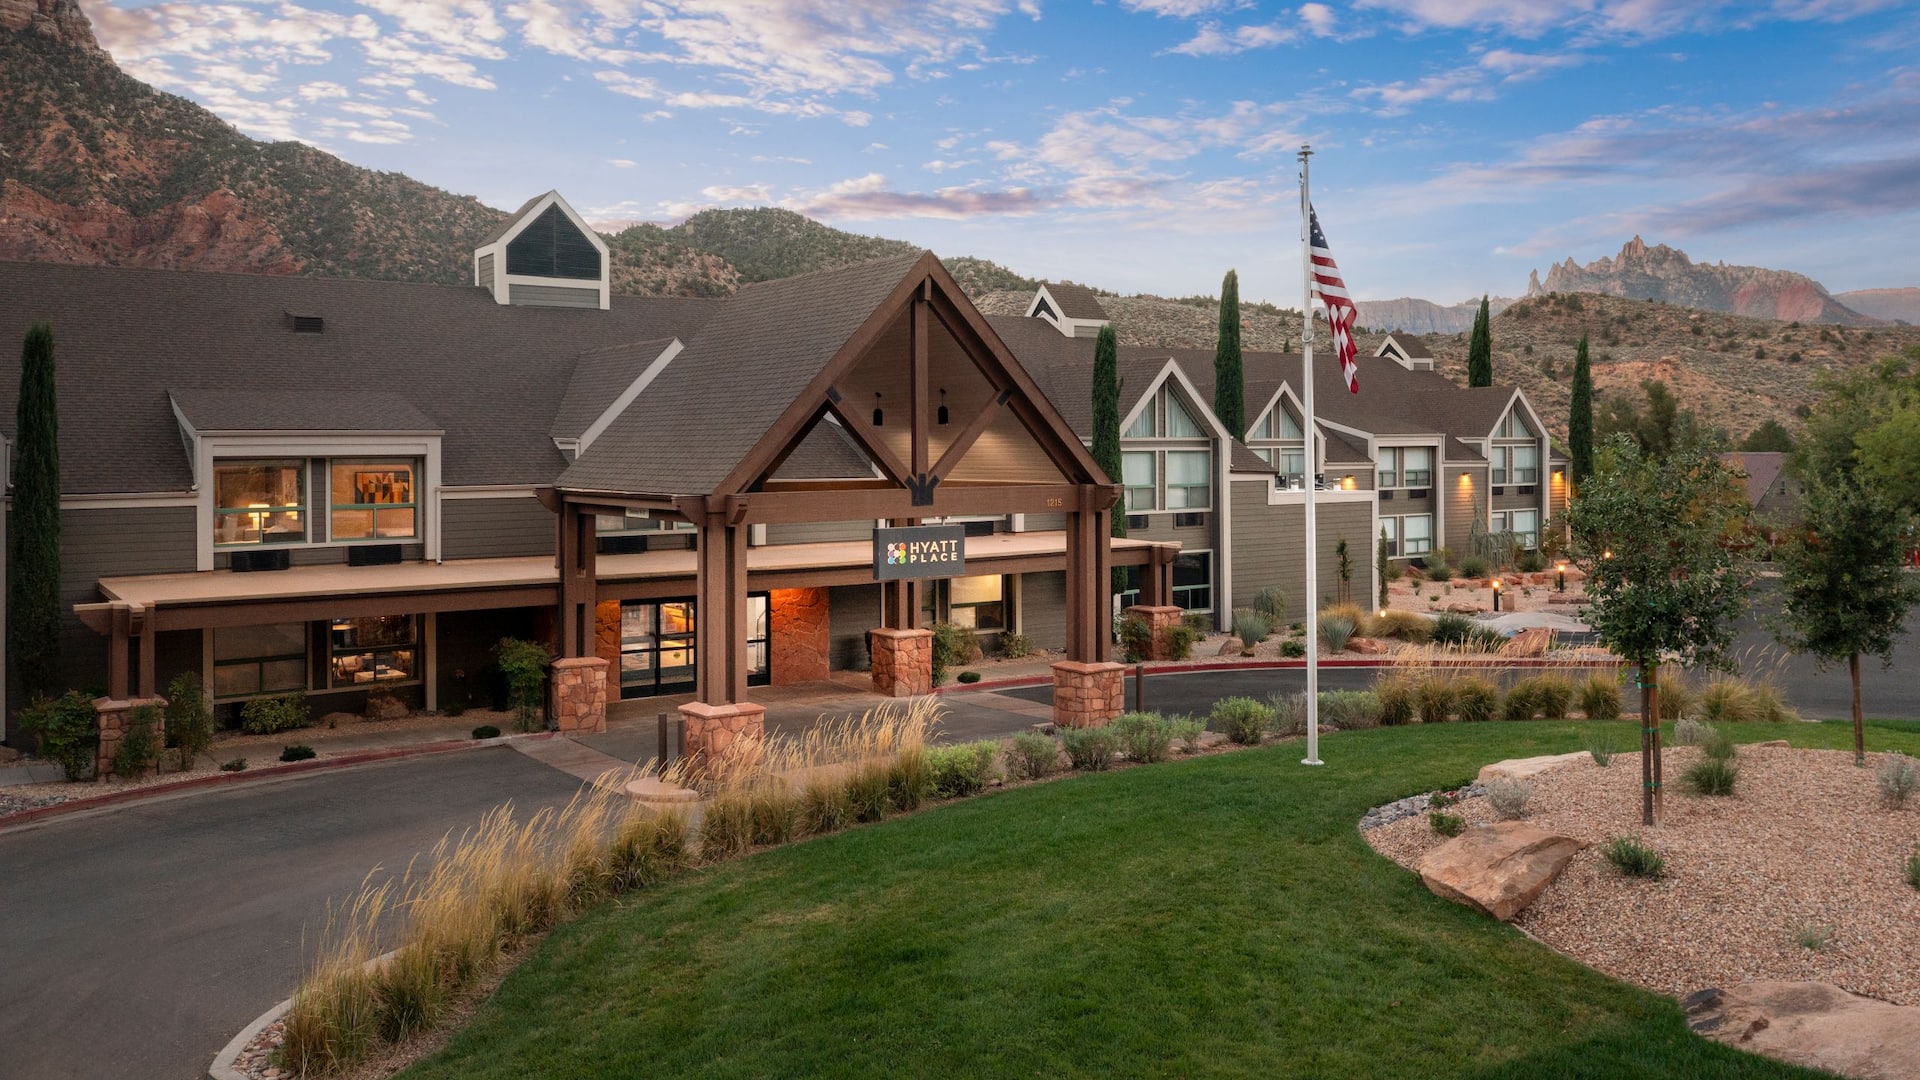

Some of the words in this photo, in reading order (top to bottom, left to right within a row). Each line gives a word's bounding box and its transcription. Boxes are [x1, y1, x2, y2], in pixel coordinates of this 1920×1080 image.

[1047, 498, 1062, 507] 1215
[910, 540, 958, 554] HYATT
[910, 552, 958, 564] PLACE
